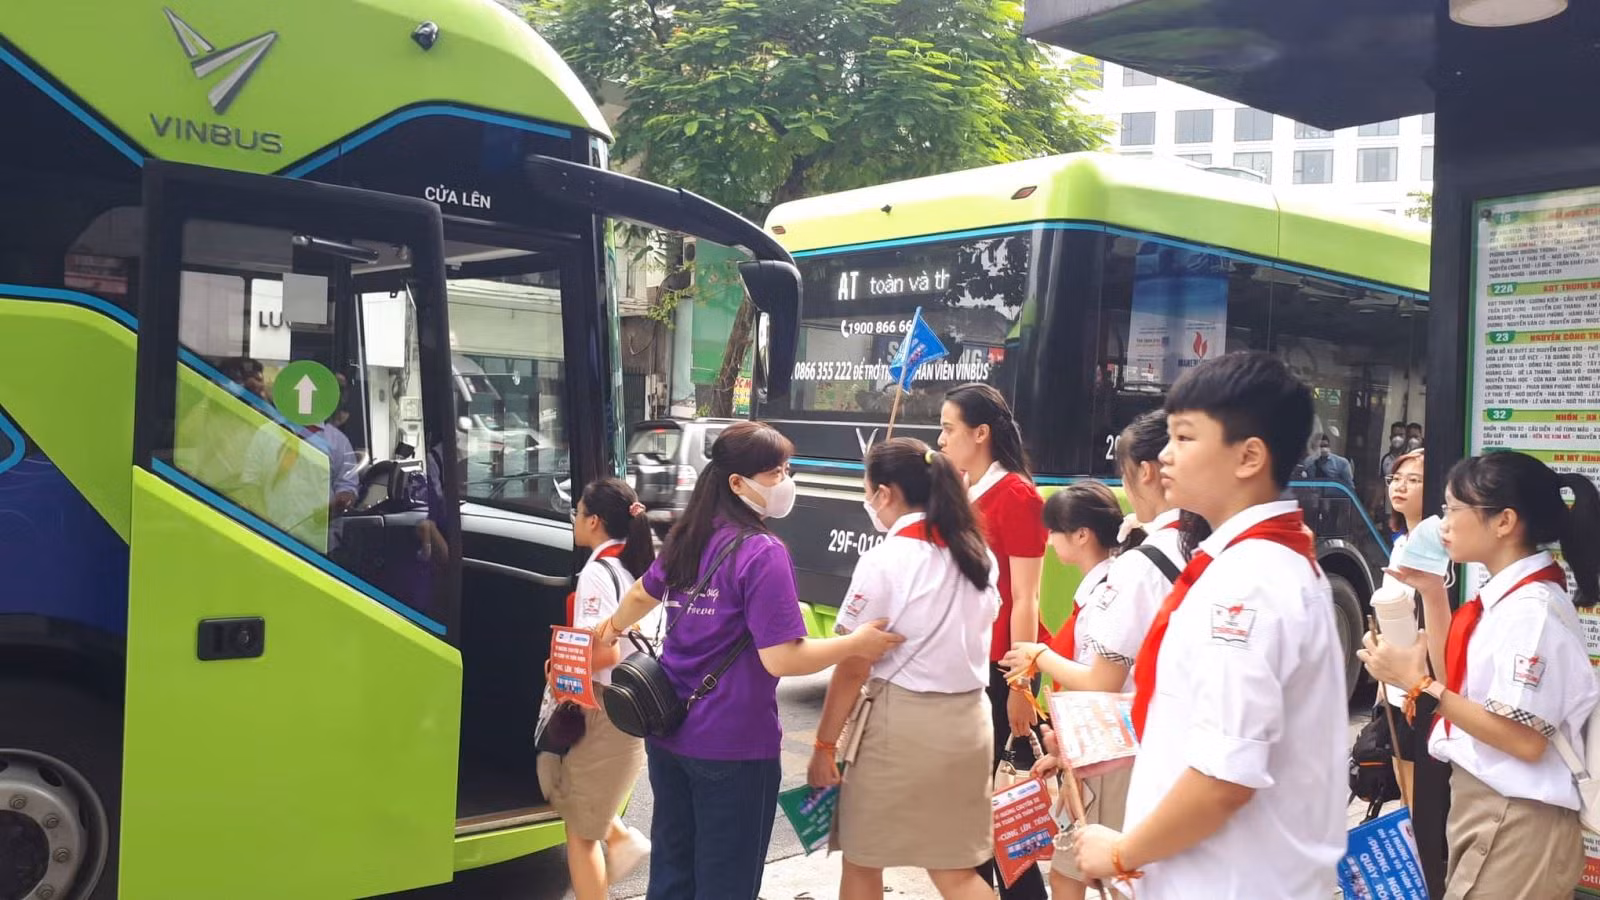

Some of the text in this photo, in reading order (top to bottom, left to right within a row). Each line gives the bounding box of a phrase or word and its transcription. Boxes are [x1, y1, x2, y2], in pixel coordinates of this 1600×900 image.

[149, 112, 283, 154] VINBUS
[424, 183, 491, 209] CỬA LÊN
[838, 271, 859, 300] AT
[870, 273, 904, 294] toàn
[909, 270, 929, 291] và
[1494, 285, 1513, 294] 22A
[259, 311, 293, 329] LU
[847, 320, 913, 334] 1900 866 66
[1495, 333, 1509, 342] 23
[795, 361, 816, 380] 0866
[816, 361, 833, 380] 355
[834, 361, 851, 381] 222
[935, 359, 955, 380] VIÊN
[955, 362, 989, 381] VINBUS
[1493, 410, 1506, 419] 32
